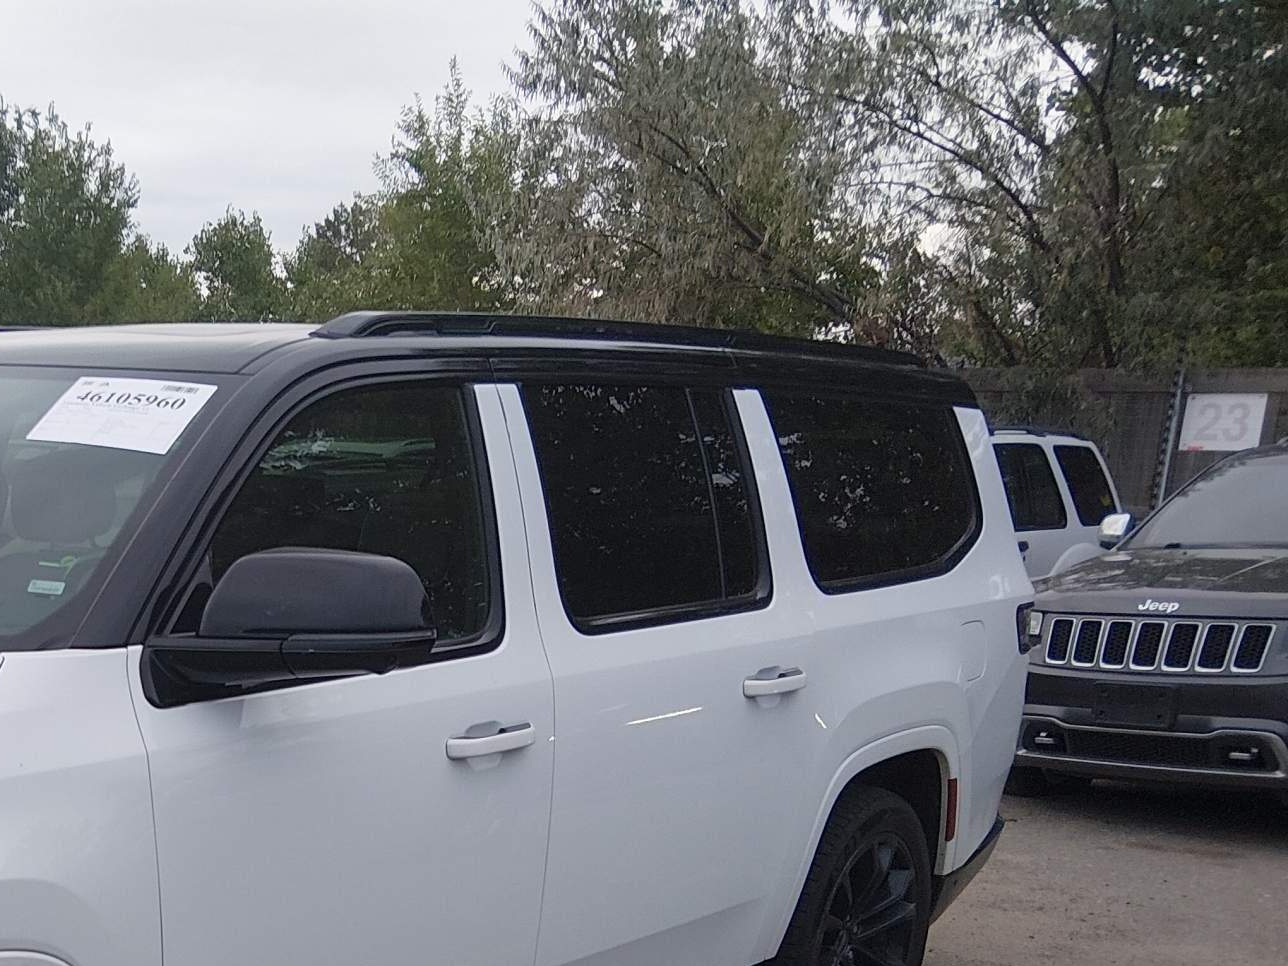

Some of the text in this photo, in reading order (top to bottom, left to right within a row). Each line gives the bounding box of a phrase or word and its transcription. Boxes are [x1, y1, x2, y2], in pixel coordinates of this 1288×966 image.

[77, 391, 186, 410] 46105960
[1193, 402, 1250, 442] 23
[1137, 599, 1180, 614] Jeep
